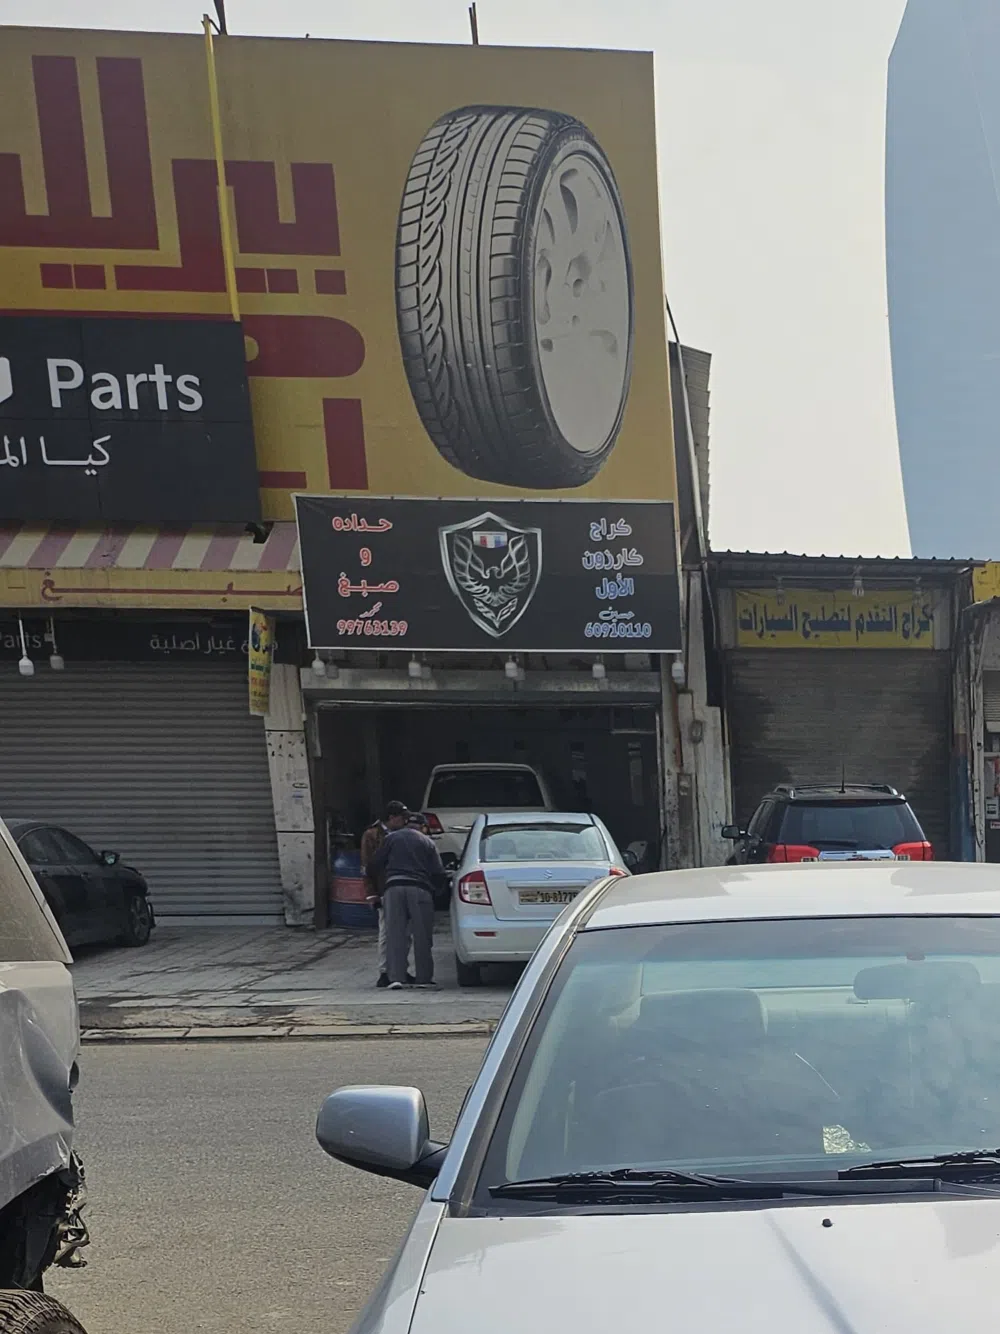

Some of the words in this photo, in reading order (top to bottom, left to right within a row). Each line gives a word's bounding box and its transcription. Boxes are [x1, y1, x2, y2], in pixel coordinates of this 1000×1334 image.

[46, 358, 203, 412] Parts
[40, 435, 111, 475] كيا
[332, 514, 393, 532] حداده
[589, 518, 632, 541] كراج
[359, 547, 372, 566] و
[582, 548, 644, 571] كارزون
[337, 572, 399, 597] صبغ
[595, 574, 634, 599] الأول
[336, 619, 408, 637] 99763139
[584, 622, 651, 638] 60910110
[855, 604, 897, 642] التقدم
[902, 604, 933, 639] كراج
[204, 637, 235, 653] غيار
